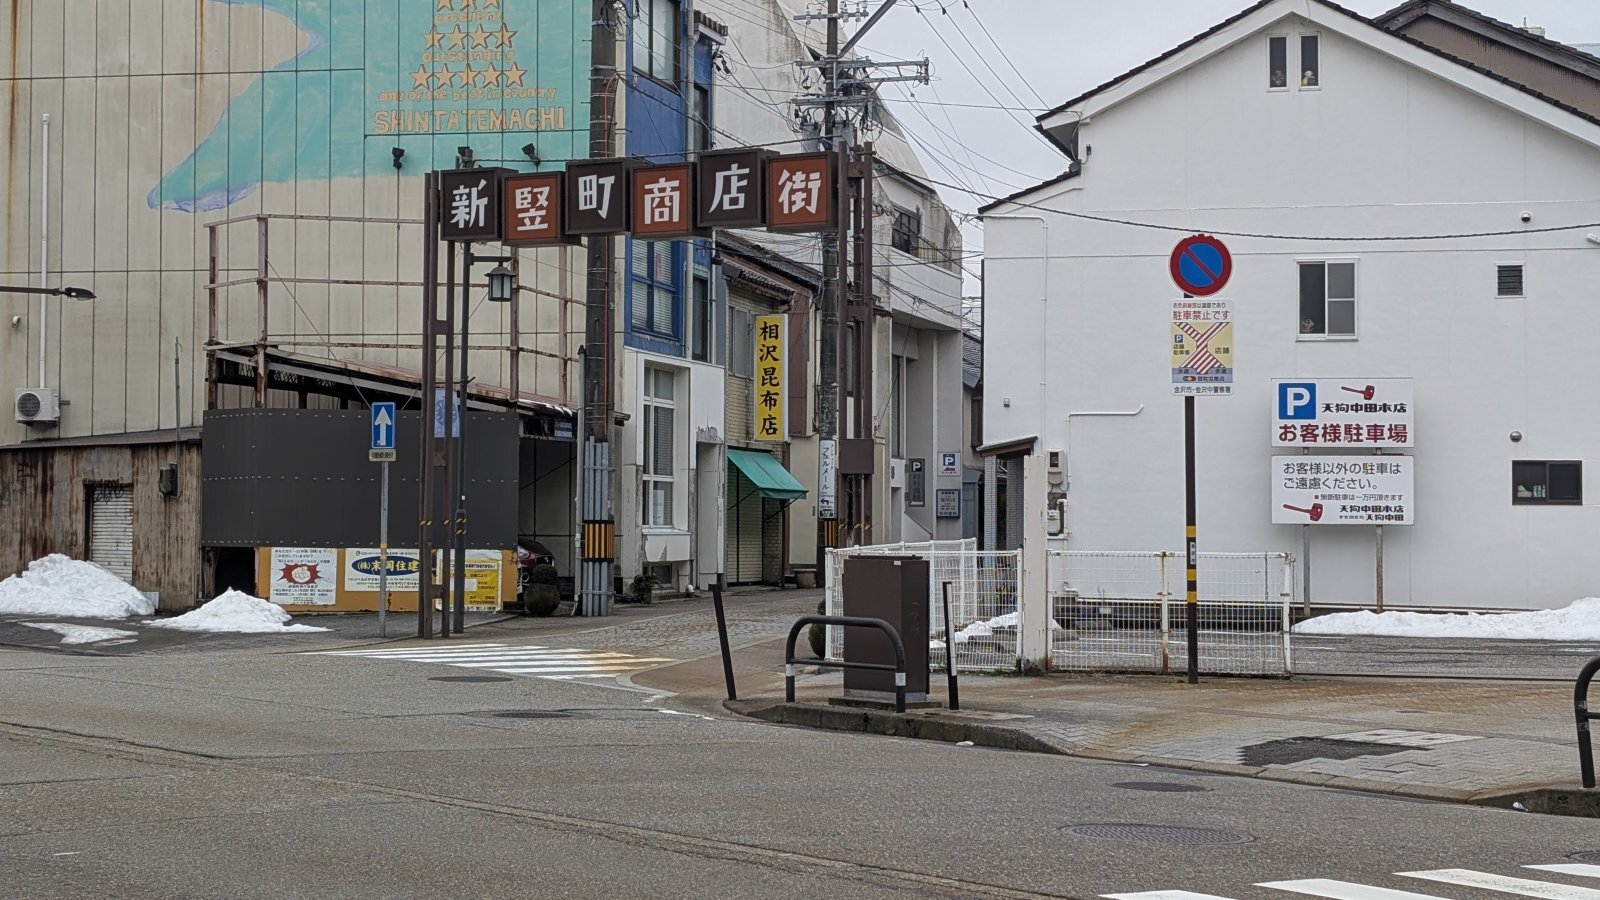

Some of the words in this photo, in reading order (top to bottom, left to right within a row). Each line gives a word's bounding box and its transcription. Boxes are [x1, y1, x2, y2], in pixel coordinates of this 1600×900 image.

[378, 91, 404, 101] one
[408, 90, 421, 102] of
[423, 89, 448, 100] the
[452, 88, 483, 100] best
[487, 88, 501, 100] in
[374, 107, 565, 134] SHINTATEMACHI
[450, 163, 822, 232] 新竪町商店街
[1172, 310, 1230, 321] 駐車禁止です
[759, 321, 780, 436] 相沢昆布店
[1287, 387, 1310, 416] P
[1321, 402, 1407, 413] 天狗中田本店
[1278, 423, 1408, 443] お客様駐車場
[821, 447, 831, 491] フェルメール
[1283, 462, 1401, 475] お客様以外の駐車は
[1283, 477, 1377, 489] ご遠慮ください。
[1339, 504, 1404, 513] 天狗中田本店
[1365, 513, 1404, 521] 天狗中田
